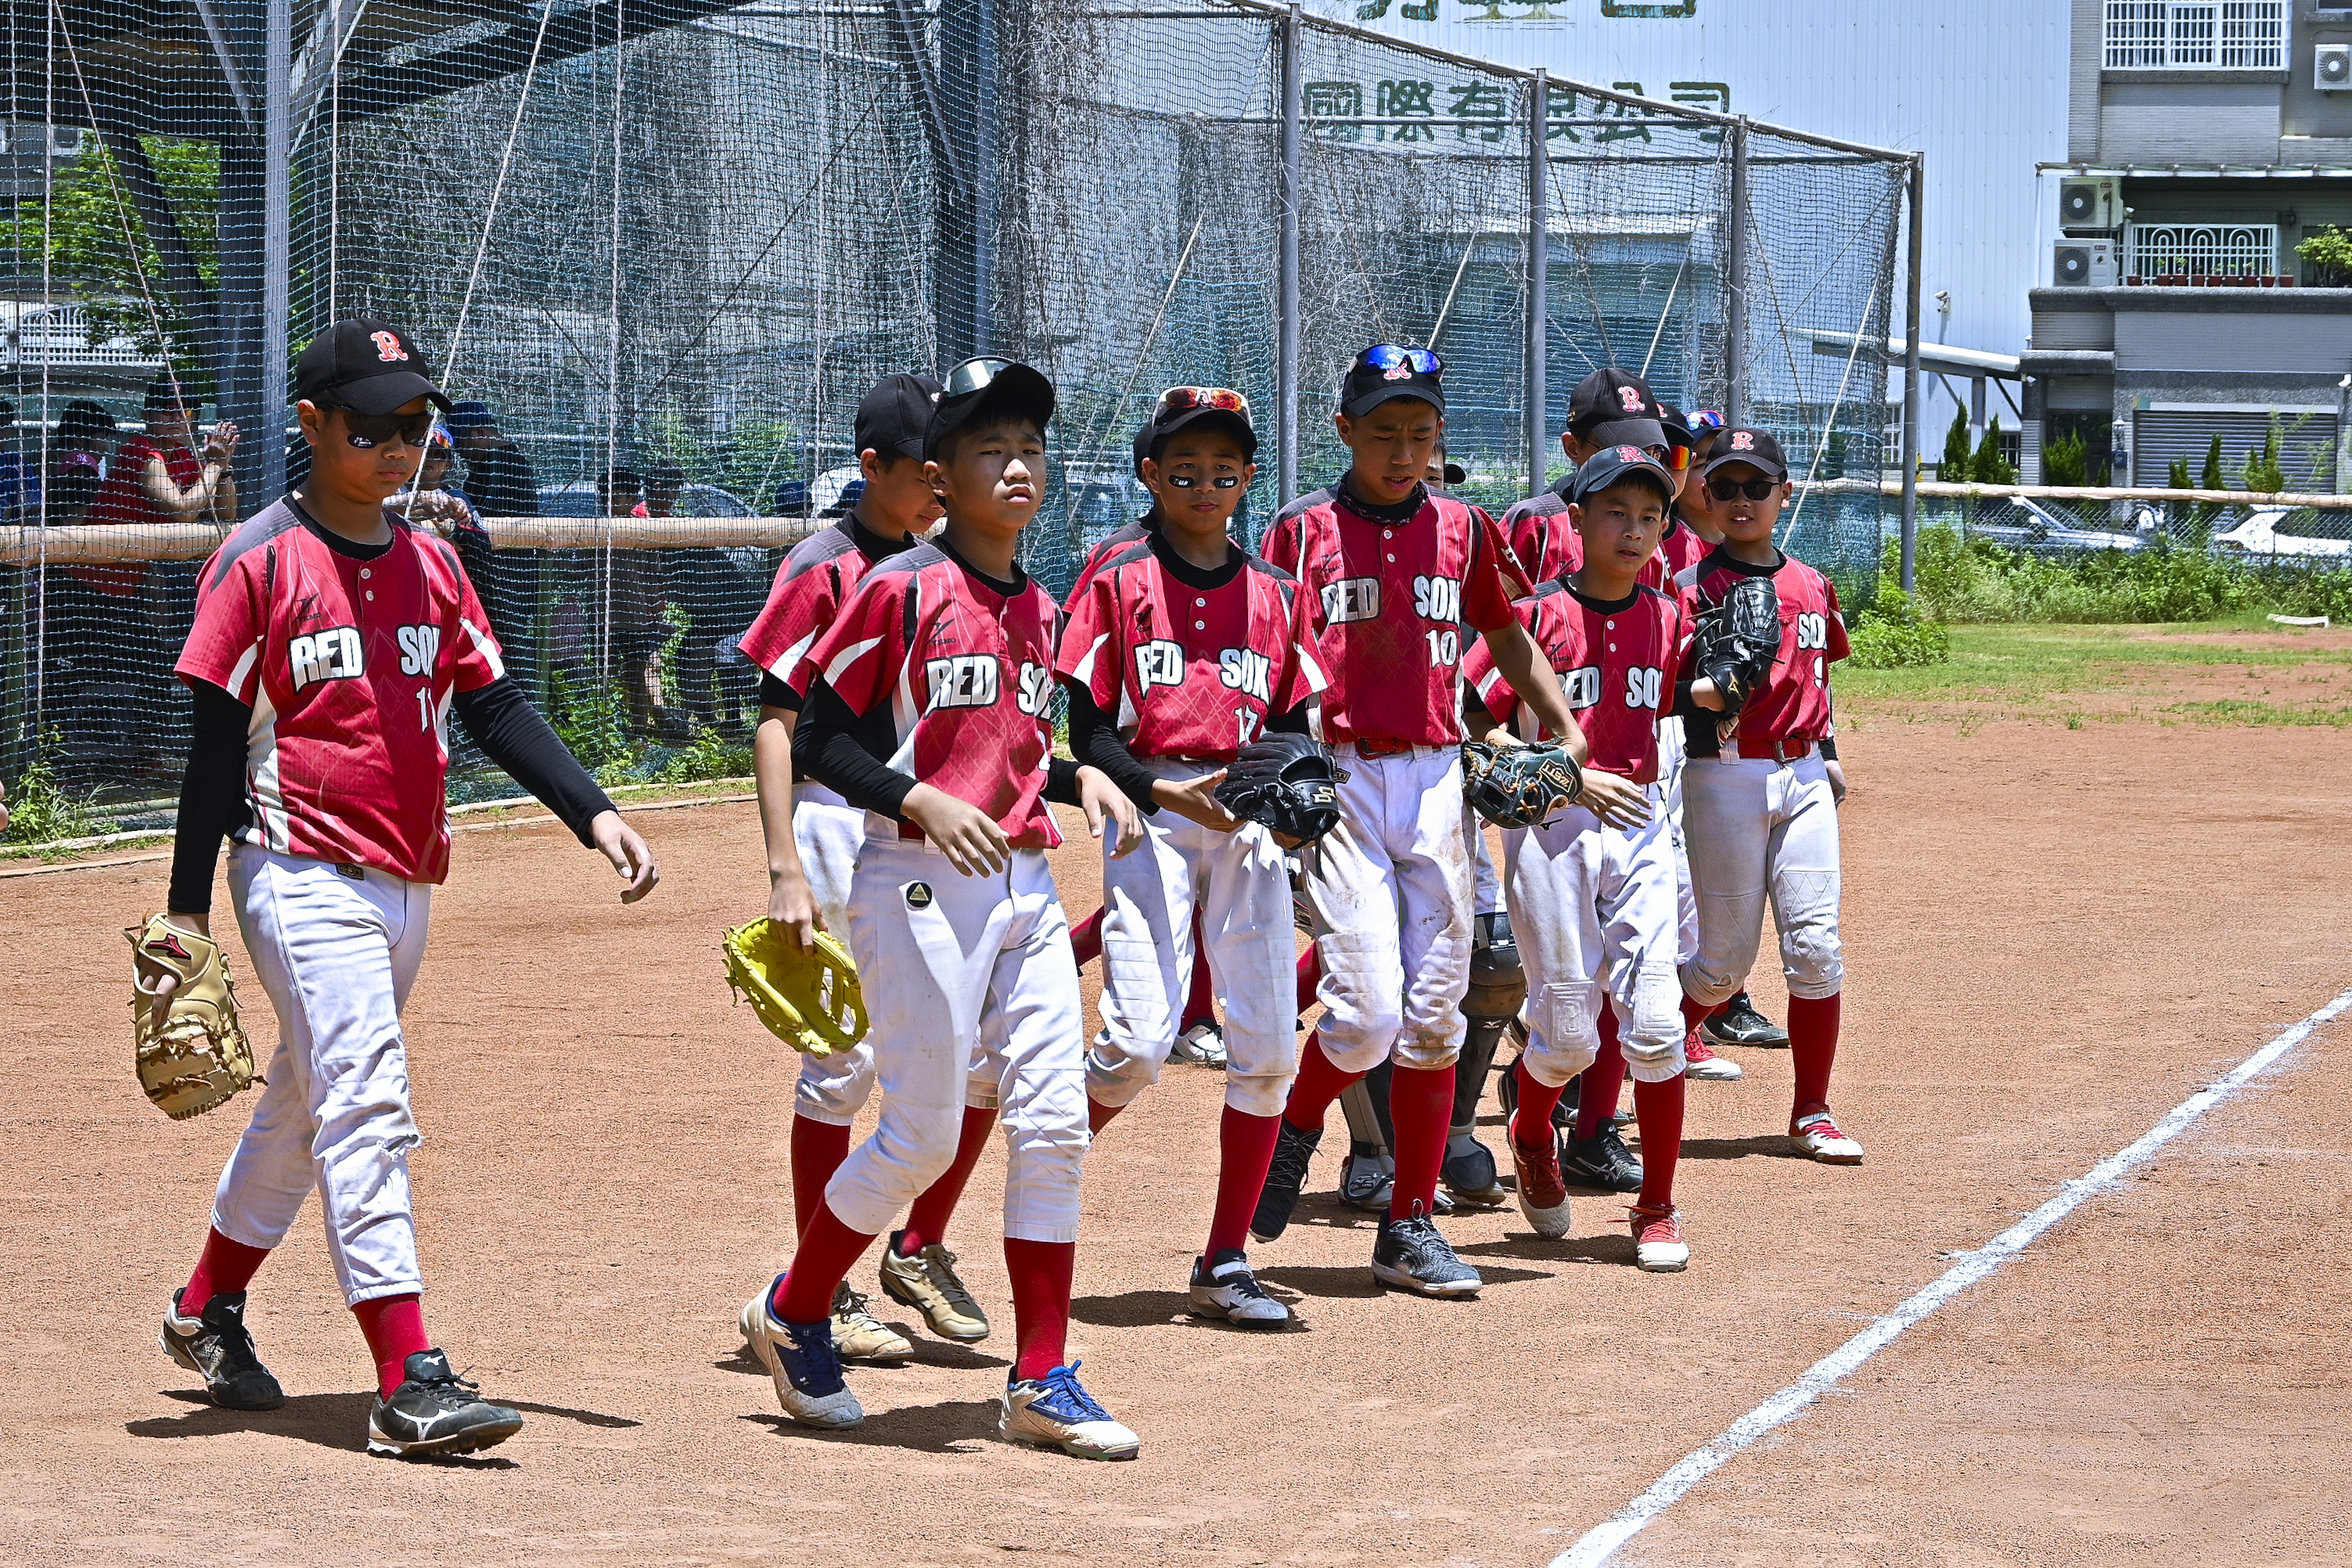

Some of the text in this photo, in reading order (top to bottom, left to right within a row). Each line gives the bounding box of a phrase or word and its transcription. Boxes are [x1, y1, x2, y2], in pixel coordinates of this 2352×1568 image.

[370, 330, 409, 361] R
[1617, 386, 1646, 412] R
[1616, 445, 1647, 463] R
[1730, 430, 1755, 451] R
[1426, 628, 1458, 670] 10
[1797, 611, 1828, 651] SO
[287, 624, 365, 695] RED
[1218, 646, 1271, 709] SOX
[922, 653, 1001, 720] RED
[1625, 665, 1663, 710] SO
[1233, 703, 1258, 747] 17
[1541, 763, 1571, 789] ZETT
